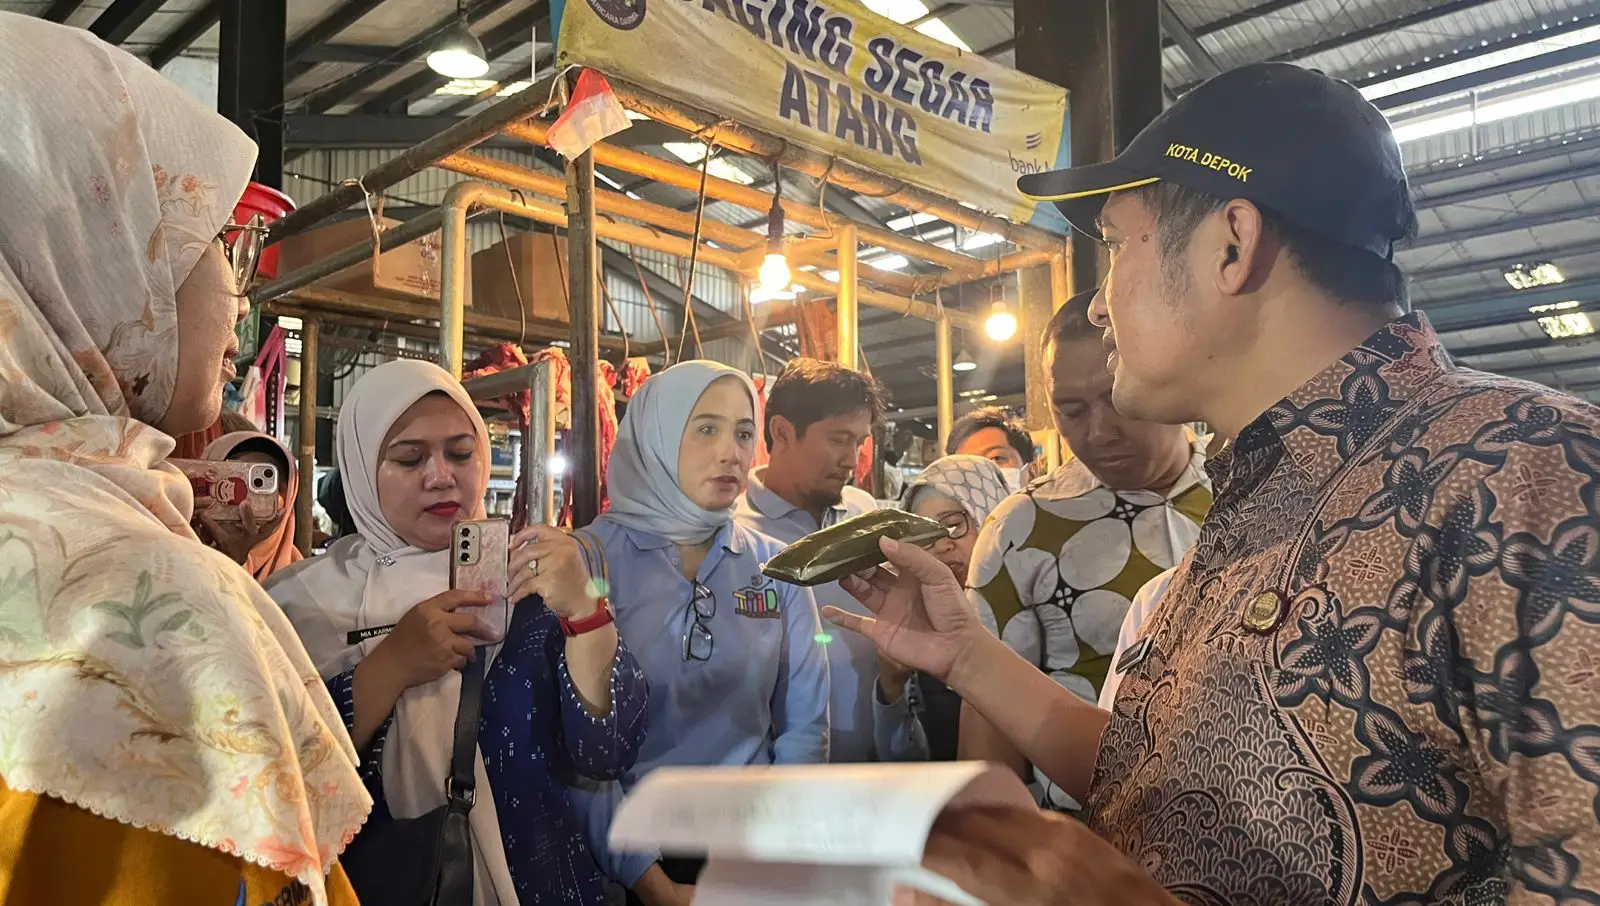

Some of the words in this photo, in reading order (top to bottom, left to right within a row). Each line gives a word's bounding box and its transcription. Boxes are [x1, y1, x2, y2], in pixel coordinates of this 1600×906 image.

[684, 0, 853, 77] GING
[864, 37, 994, 133] SEGAR
[779, 60, 922, 166] ATANG
[1166, 143, 1199, 162] KOTA
[1201, 152, 1252, 182] DEPOK
[360, 630, 372, 638] MIA
